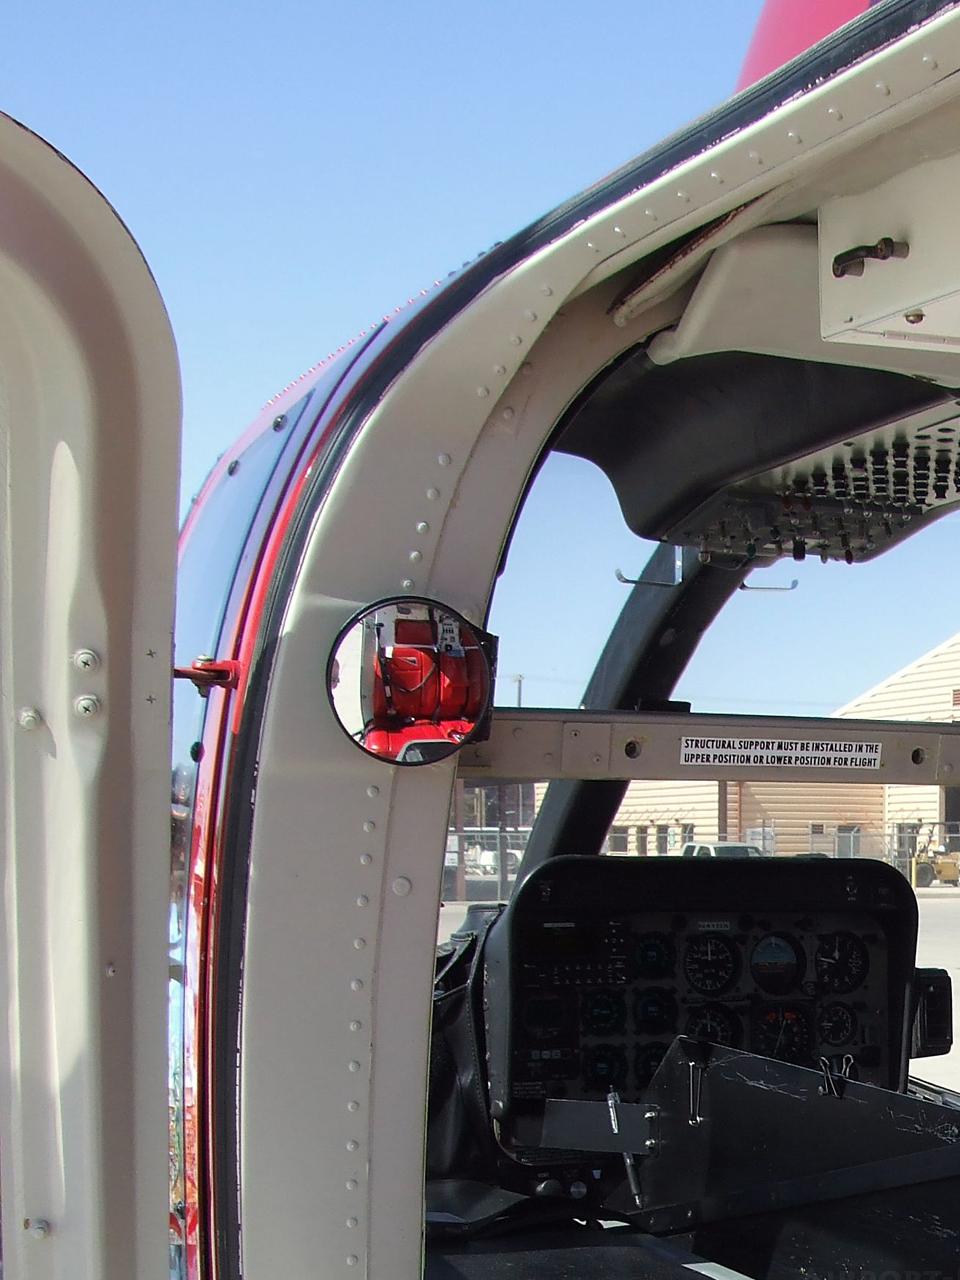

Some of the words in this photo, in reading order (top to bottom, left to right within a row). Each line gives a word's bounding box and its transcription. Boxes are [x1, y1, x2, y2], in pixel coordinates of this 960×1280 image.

[684, 739, 736, 750] STRUCTURAL
[738, 741, 776, 751] SUPPORT
[776, 742, 800, 752] MUST
[800, 743, 811, 752] BE
[811, 743, 853, 754] INSTALLED
[854, 744, 864, 754] IN
[865, 744, 879, 754] THE
[684, 753, 711, 763] UPPER
[712, 754, 751, 764] POSITION
[753, 756, 765, 765] OR
[765, 755, 793, 765] LOWER
[794, 757, 832, 766] POSITION
[833, 757, 849, 767] FOR
[850, 757, 877, 768] FLIGHT
